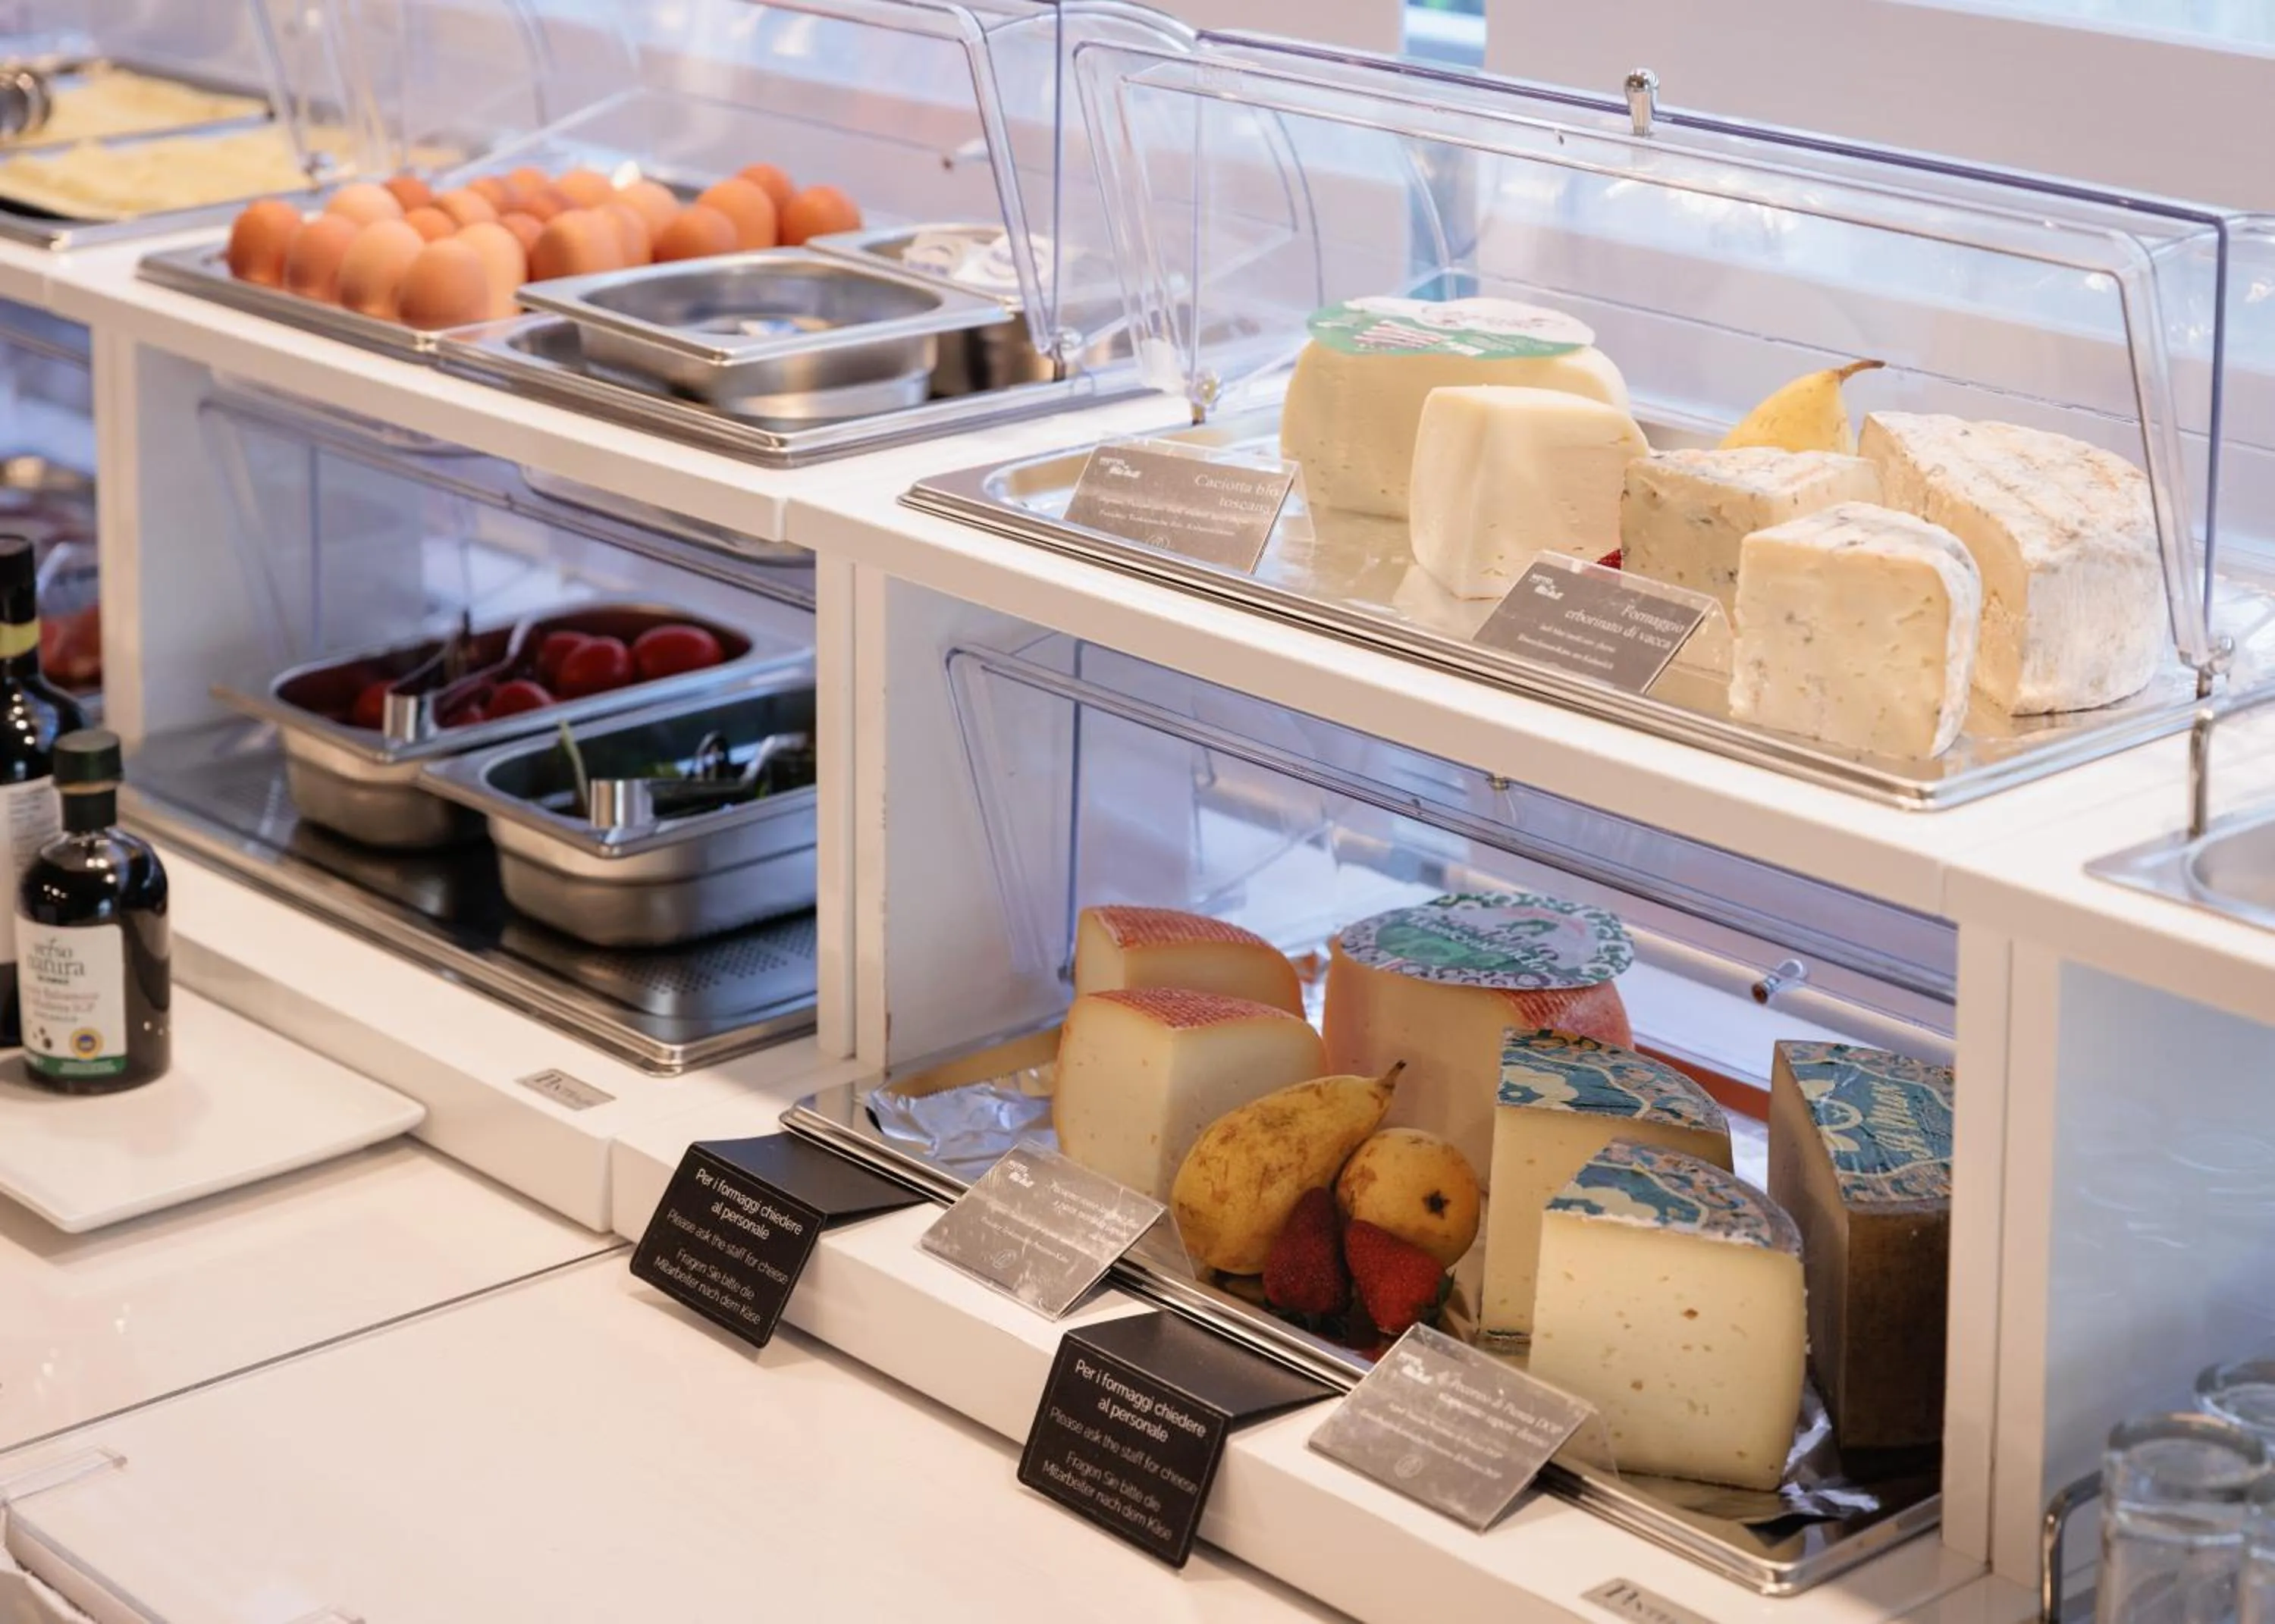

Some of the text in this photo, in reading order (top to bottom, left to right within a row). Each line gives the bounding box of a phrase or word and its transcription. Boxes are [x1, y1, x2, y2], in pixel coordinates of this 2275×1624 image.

[1621, 604, 1685, 634] Formaggio
[695, 1168, 803, 1235] Per i formaggi chiedere
[711, 1202, 770, 1240] al personale
[667, 1208, 696, 1234] Please
[695, 1227, 712, 1243] ask
[711, 1234, 726, 1251] the
[725, 1243, 748, 1260] staff
[744, 1252, 759, 1268] for
[1075, 1359, 1207, 1437] Per i formaggi chiedere
[1097, 1397, 1169, 1443] al personale
[1050, 1406, 1084, 1434] Please
[1083, 1428, 1102, 1444] ask
[1102, 1434, 1121, 1453] the
[1120, 1446, 1145, 1466] staff
[1144, 1456, 1160, 1473] for
